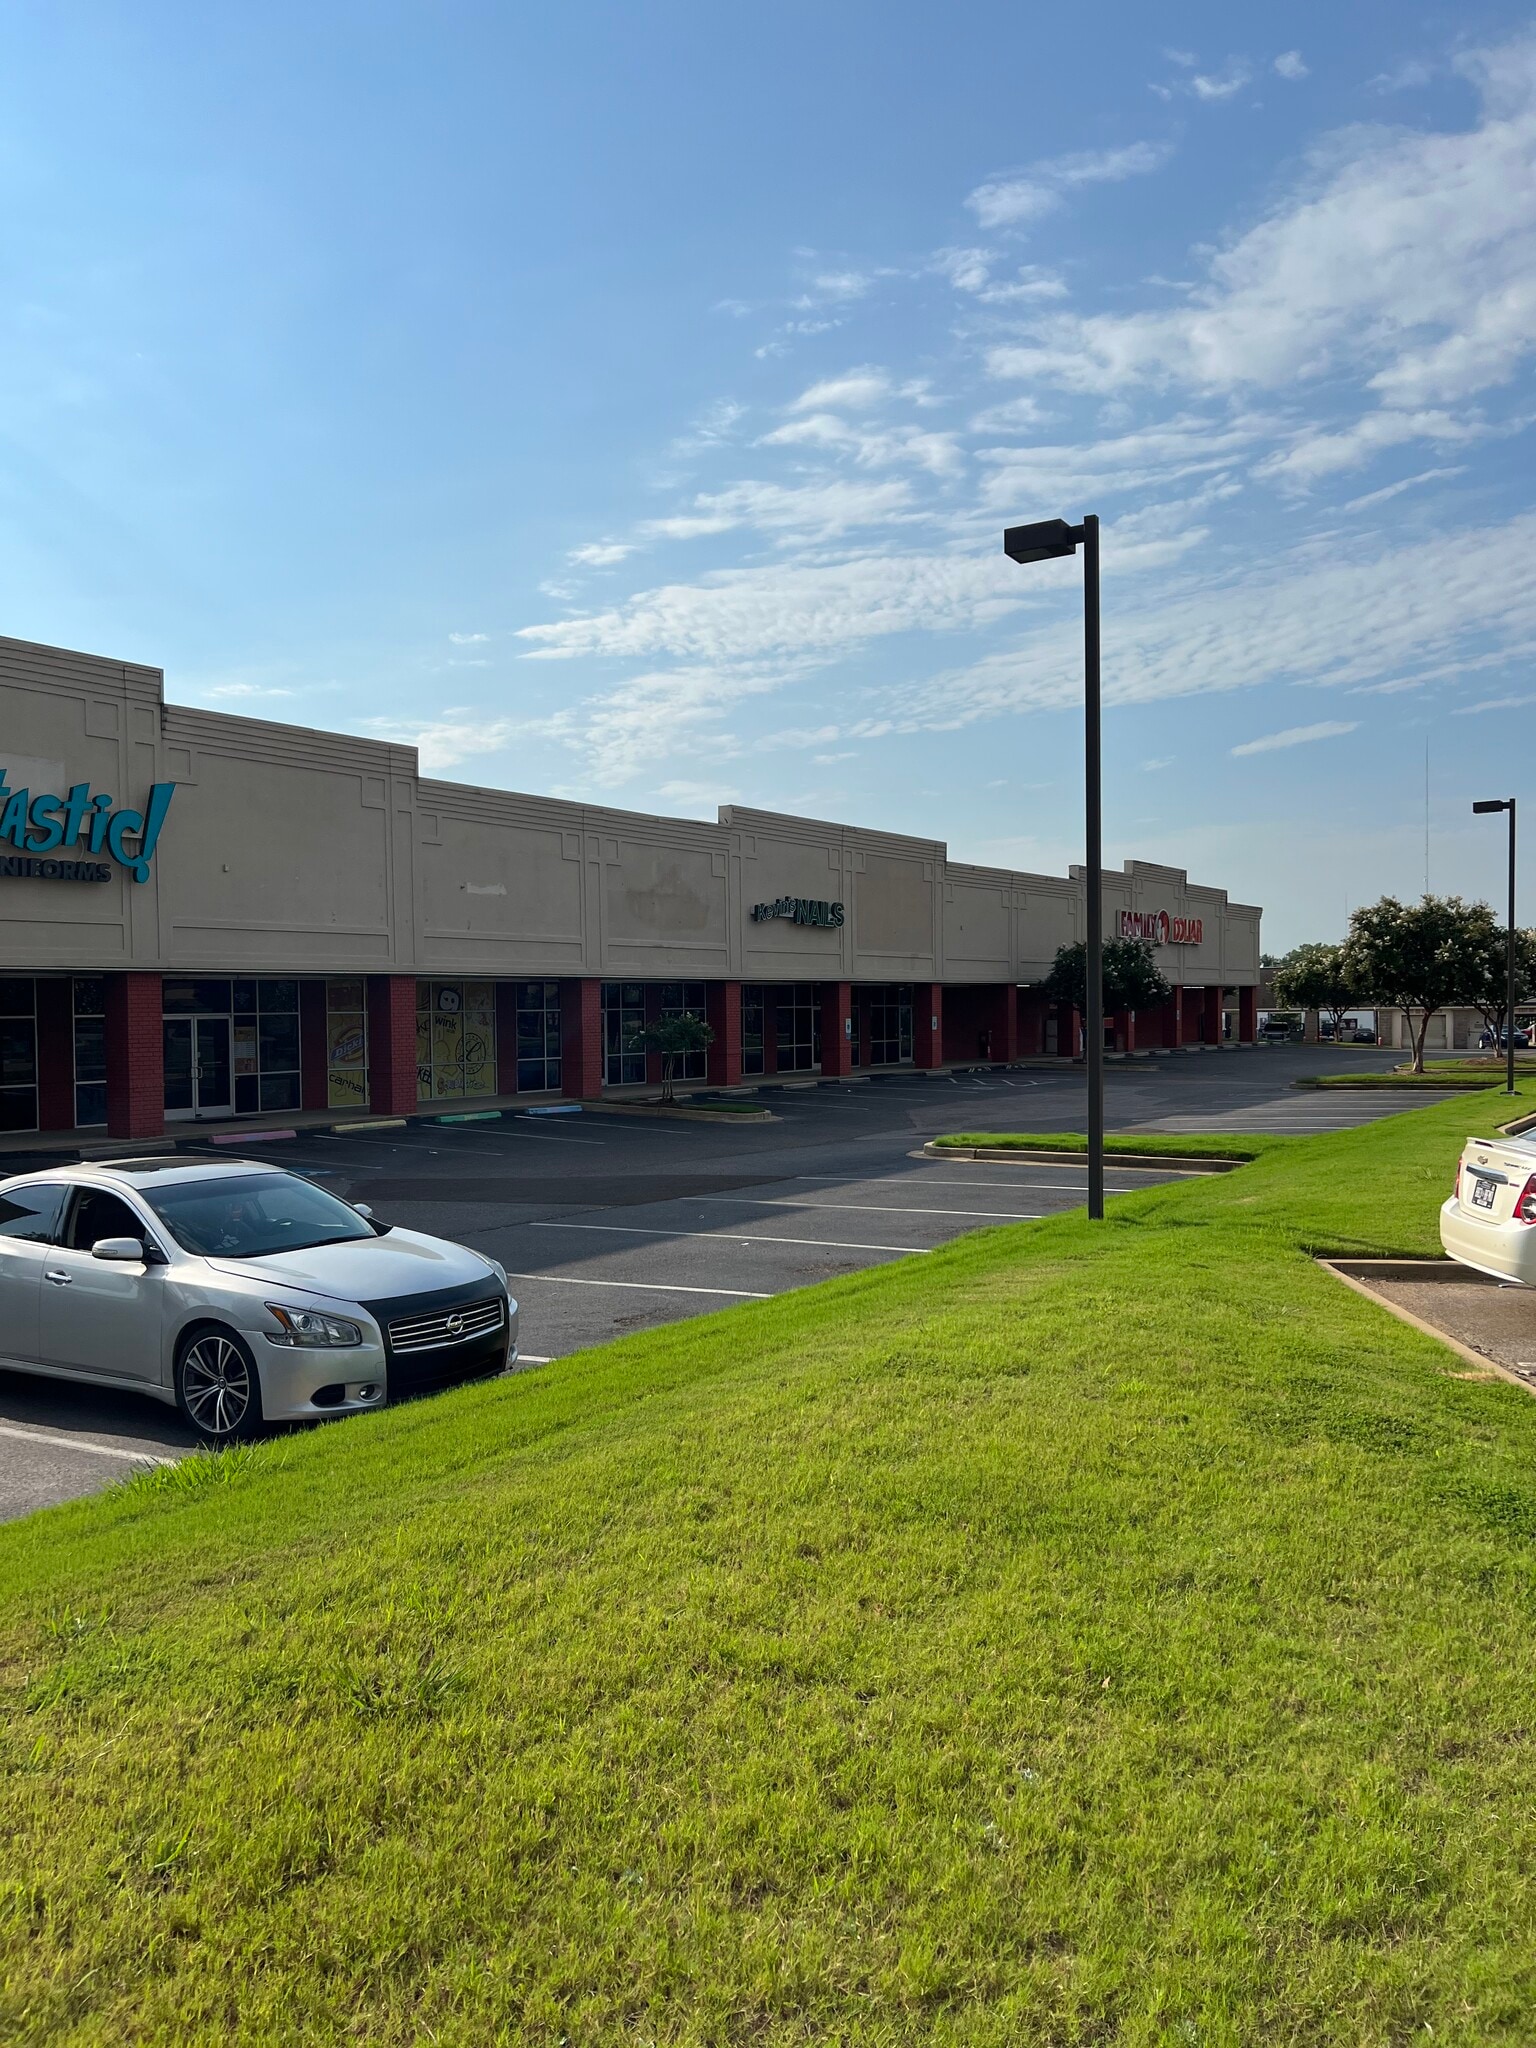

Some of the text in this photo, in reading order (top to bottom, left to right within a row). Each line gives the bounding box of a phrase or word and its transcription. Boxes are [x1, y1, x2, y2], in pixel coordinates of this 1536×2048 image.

[794, 899, 844, 928] NAILS
[1121, 910, 1203, 944] FAMILY DOLLAR
[435, 1015, 457, 1030] wink
